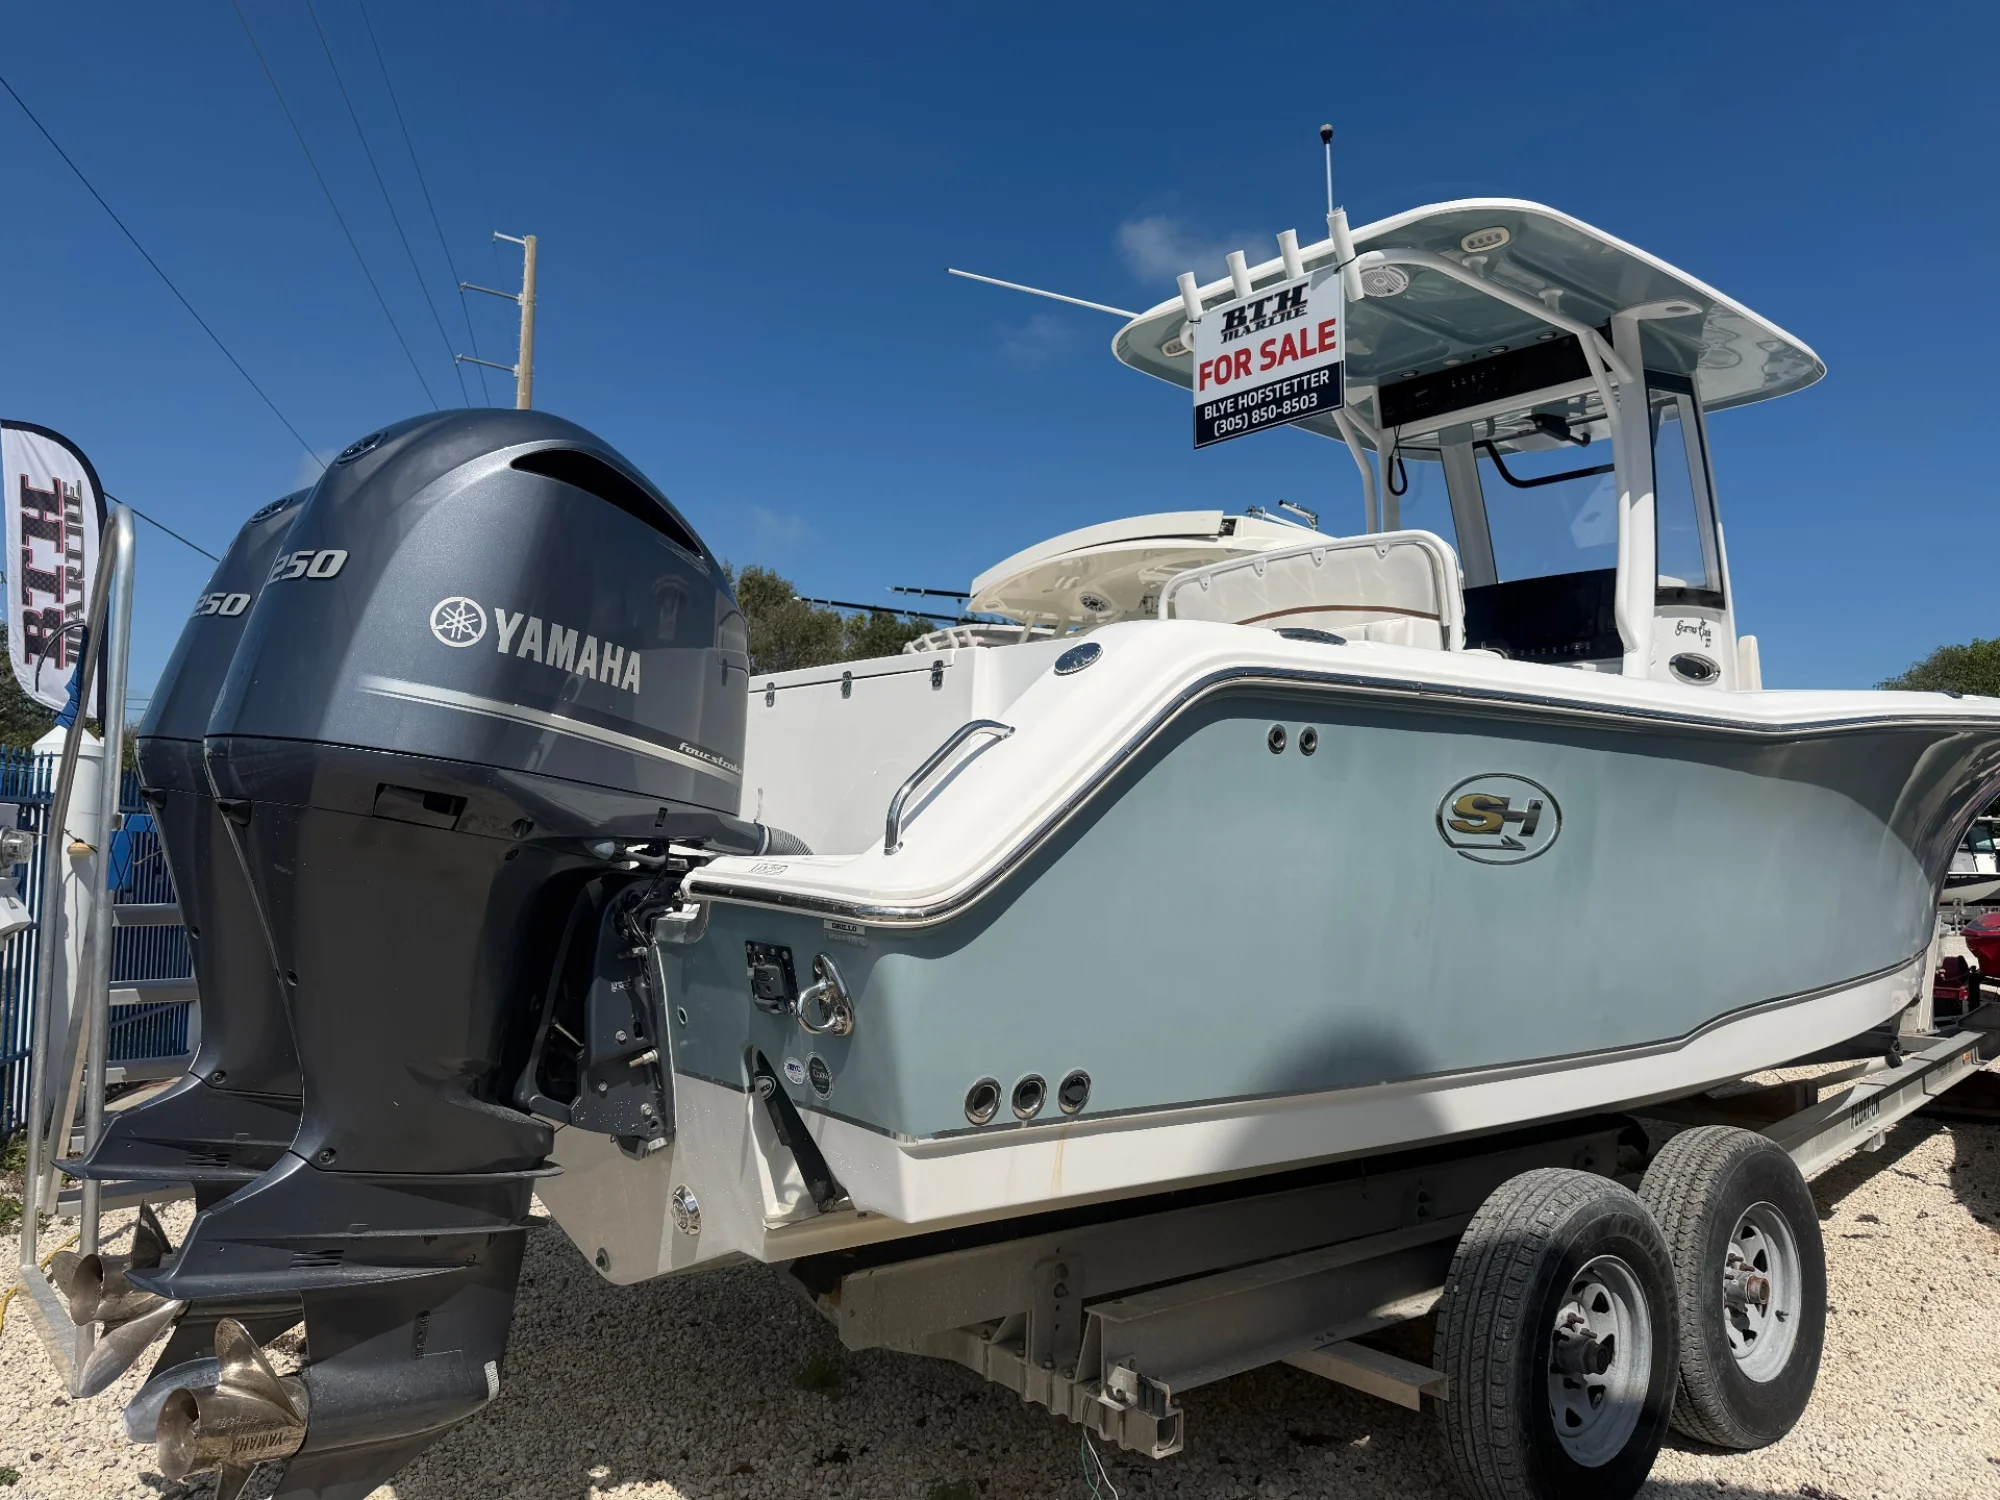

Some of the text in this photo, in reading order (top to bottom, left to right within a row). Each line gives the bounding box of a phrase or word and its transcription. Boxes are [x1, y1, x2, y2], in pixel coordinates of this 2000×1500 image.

[1220, 282, 1309, 333] BTH
[1220, 303, 1308, 344] MARINE
[1199, 318, 1336, 392] FOR SALE
[1204, 369, 1330, 420] BLYE HOFSTETTER
[1214, 393, 1318, 437] (305) 850-8503
[20, 473, 64, 671] BTH
[63, 479, 85, 668] MARINE
[266, 549, 348, 586] 250
[190, 592, 251, 617] 250
[494, 607, 640, 694] YAMAHA
[231, 1431, 283, 1451] YAMAHA
